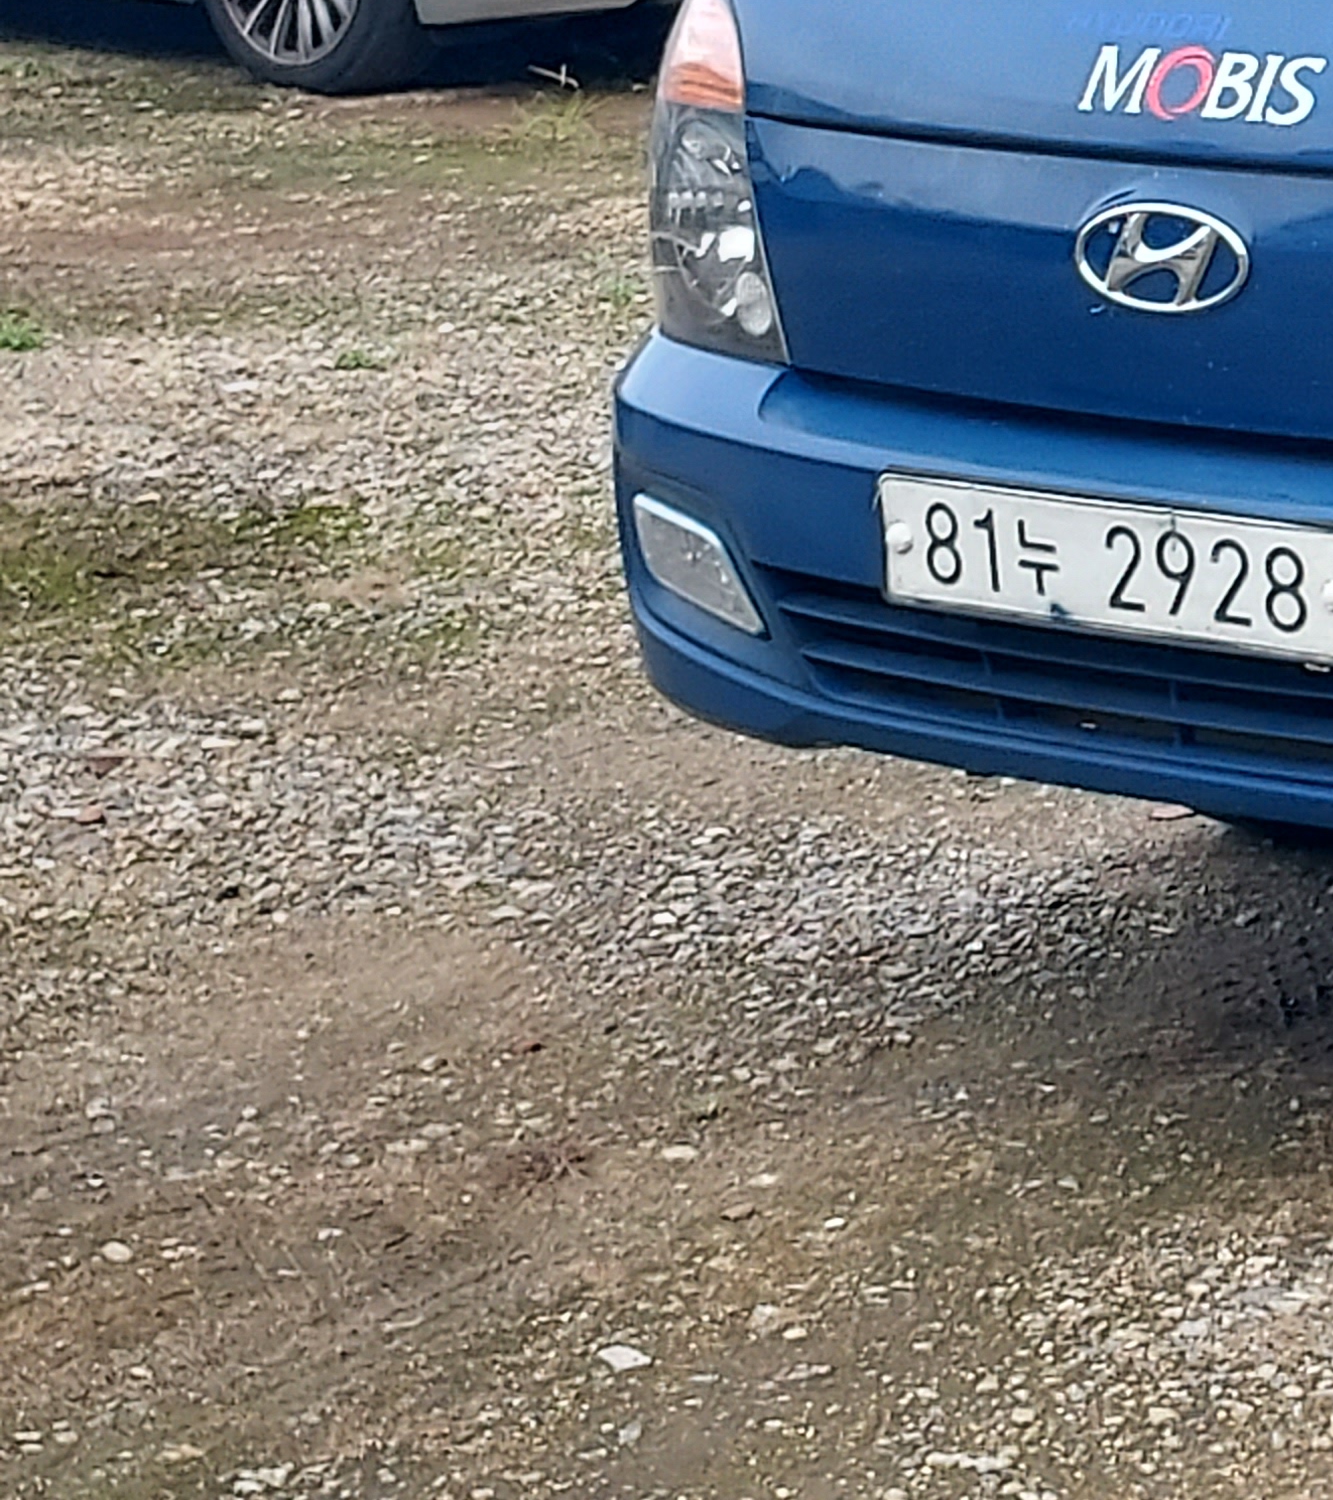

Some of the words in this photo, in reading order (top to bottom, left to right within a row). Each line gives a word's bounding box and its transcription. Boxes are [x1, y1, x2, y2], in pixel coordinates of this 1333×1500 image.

[1076, 43, 1329, 128] MOBIS
[924, 501, 1060, 597] 81누
[1105, 524, 1309, 634] 2928
